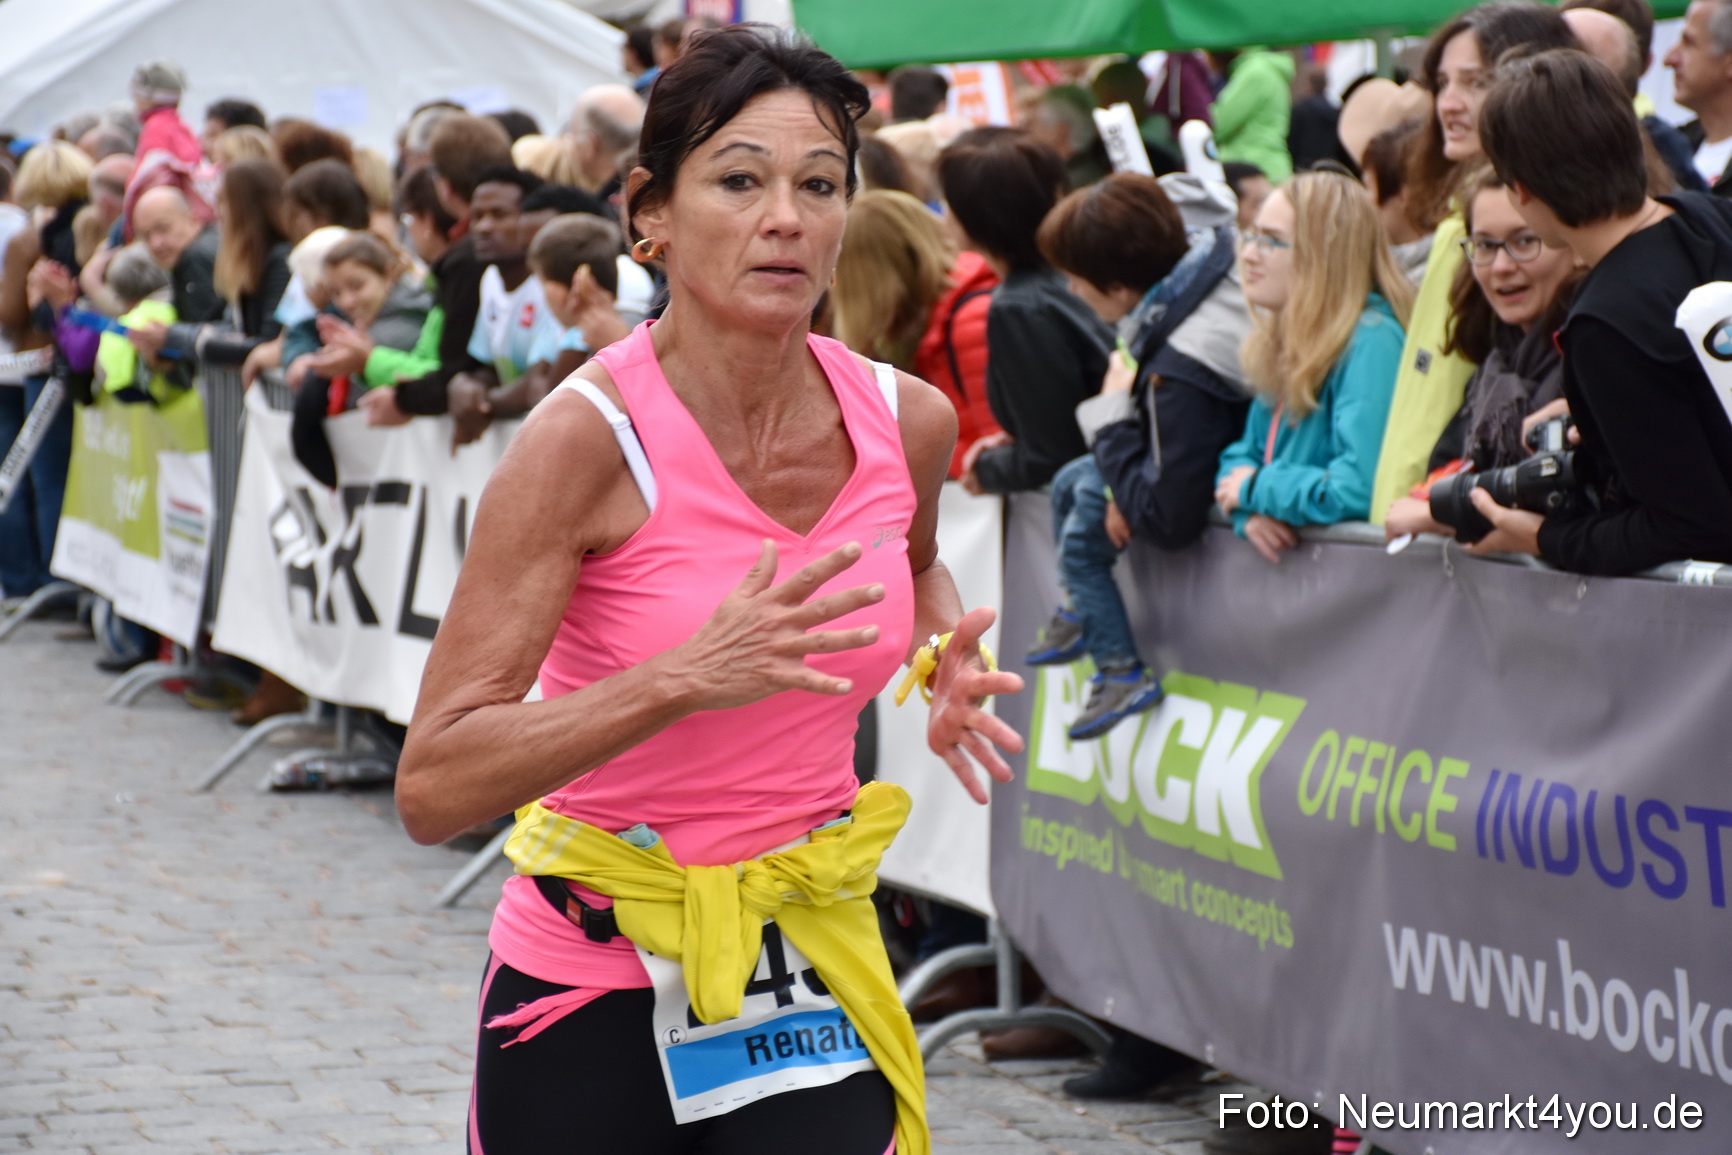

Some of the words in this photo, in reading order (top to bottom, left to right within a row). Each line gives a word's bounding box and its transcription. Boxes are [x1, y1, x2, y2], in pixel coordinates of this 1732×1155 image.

[1298, 729, 1470, 852] OFFICE
[1476, 769, 1732, 909] INDUST
[1191, 880, 1295, 951] concepts
